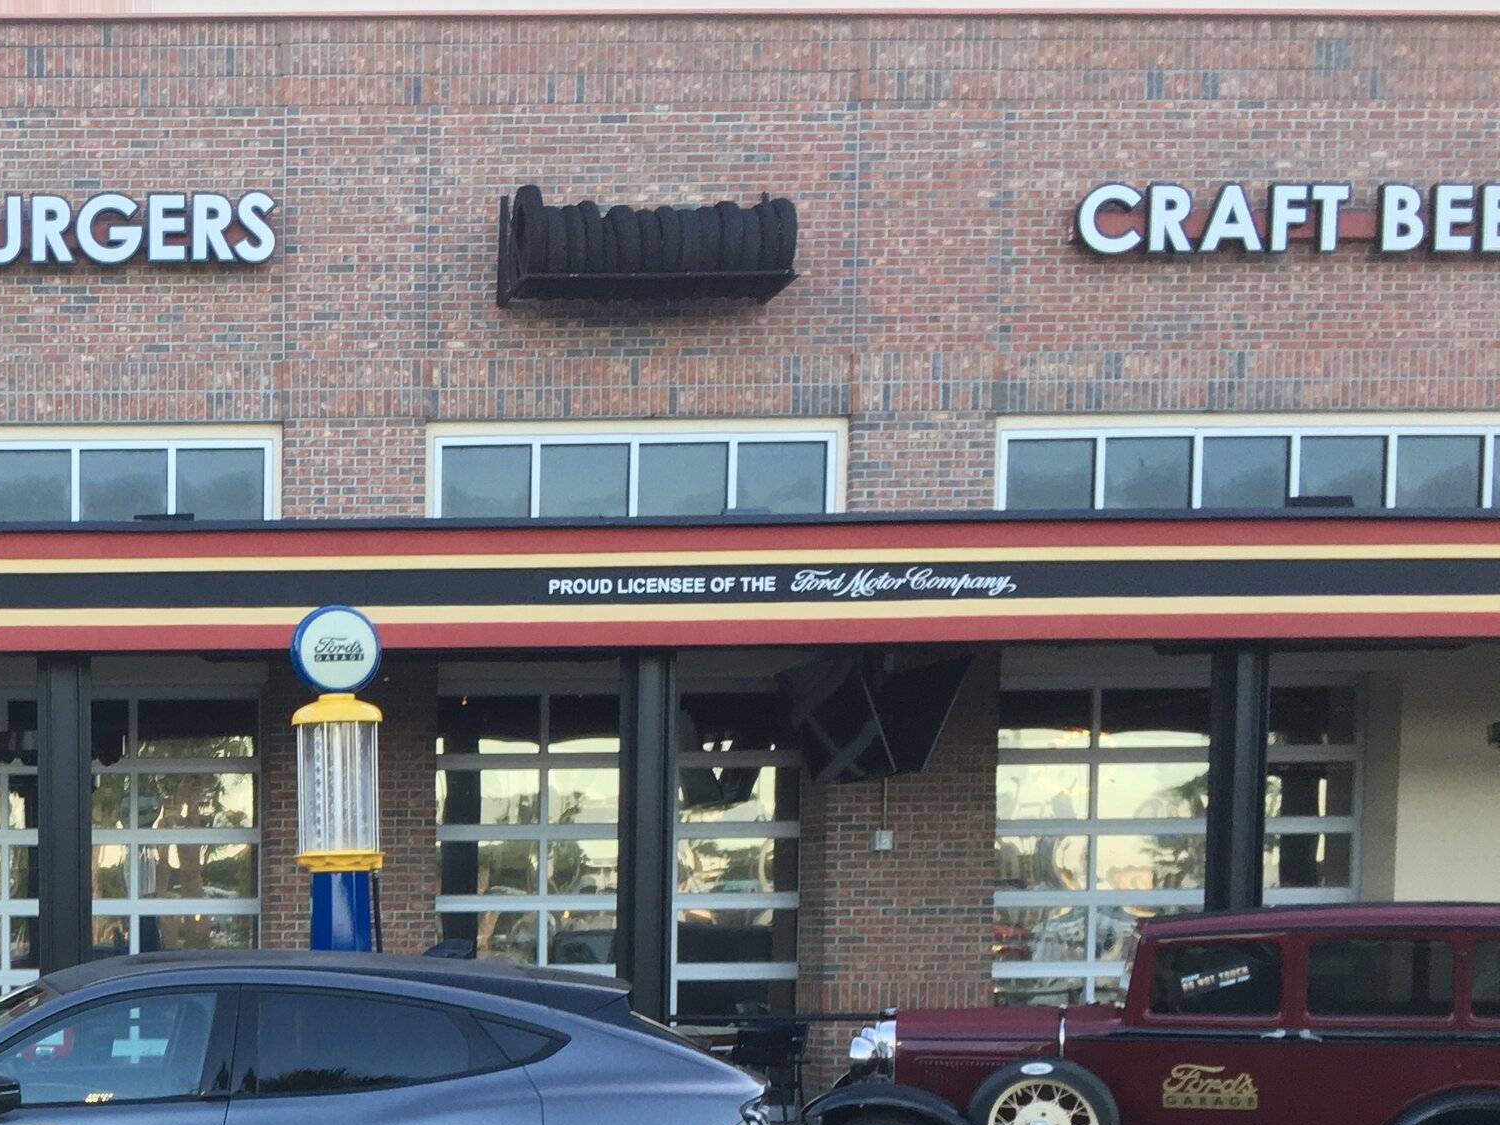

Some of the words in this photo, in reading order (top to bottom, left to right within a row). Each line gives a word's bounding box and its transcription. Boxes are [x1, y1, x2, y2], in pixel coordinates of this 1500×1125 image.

[1077, 184, 1351, 254] CRAFT
[548, 578, 613, 595] PROUD
[617, 577, 706, 594] LICENSEE
[710, 576, 735, 593] OF
[740, 576, 777, 592] THE
[790, 569, 847, 593] Ford
[832, 568, 907, 598] Motor
[905, 566, 1018, 597] Company
[314, 637, 364, 653] Ford's
[1163, 1064, 1258, 1096] Ford's
[1166, 1096, 1255, 1106] GARAGE
